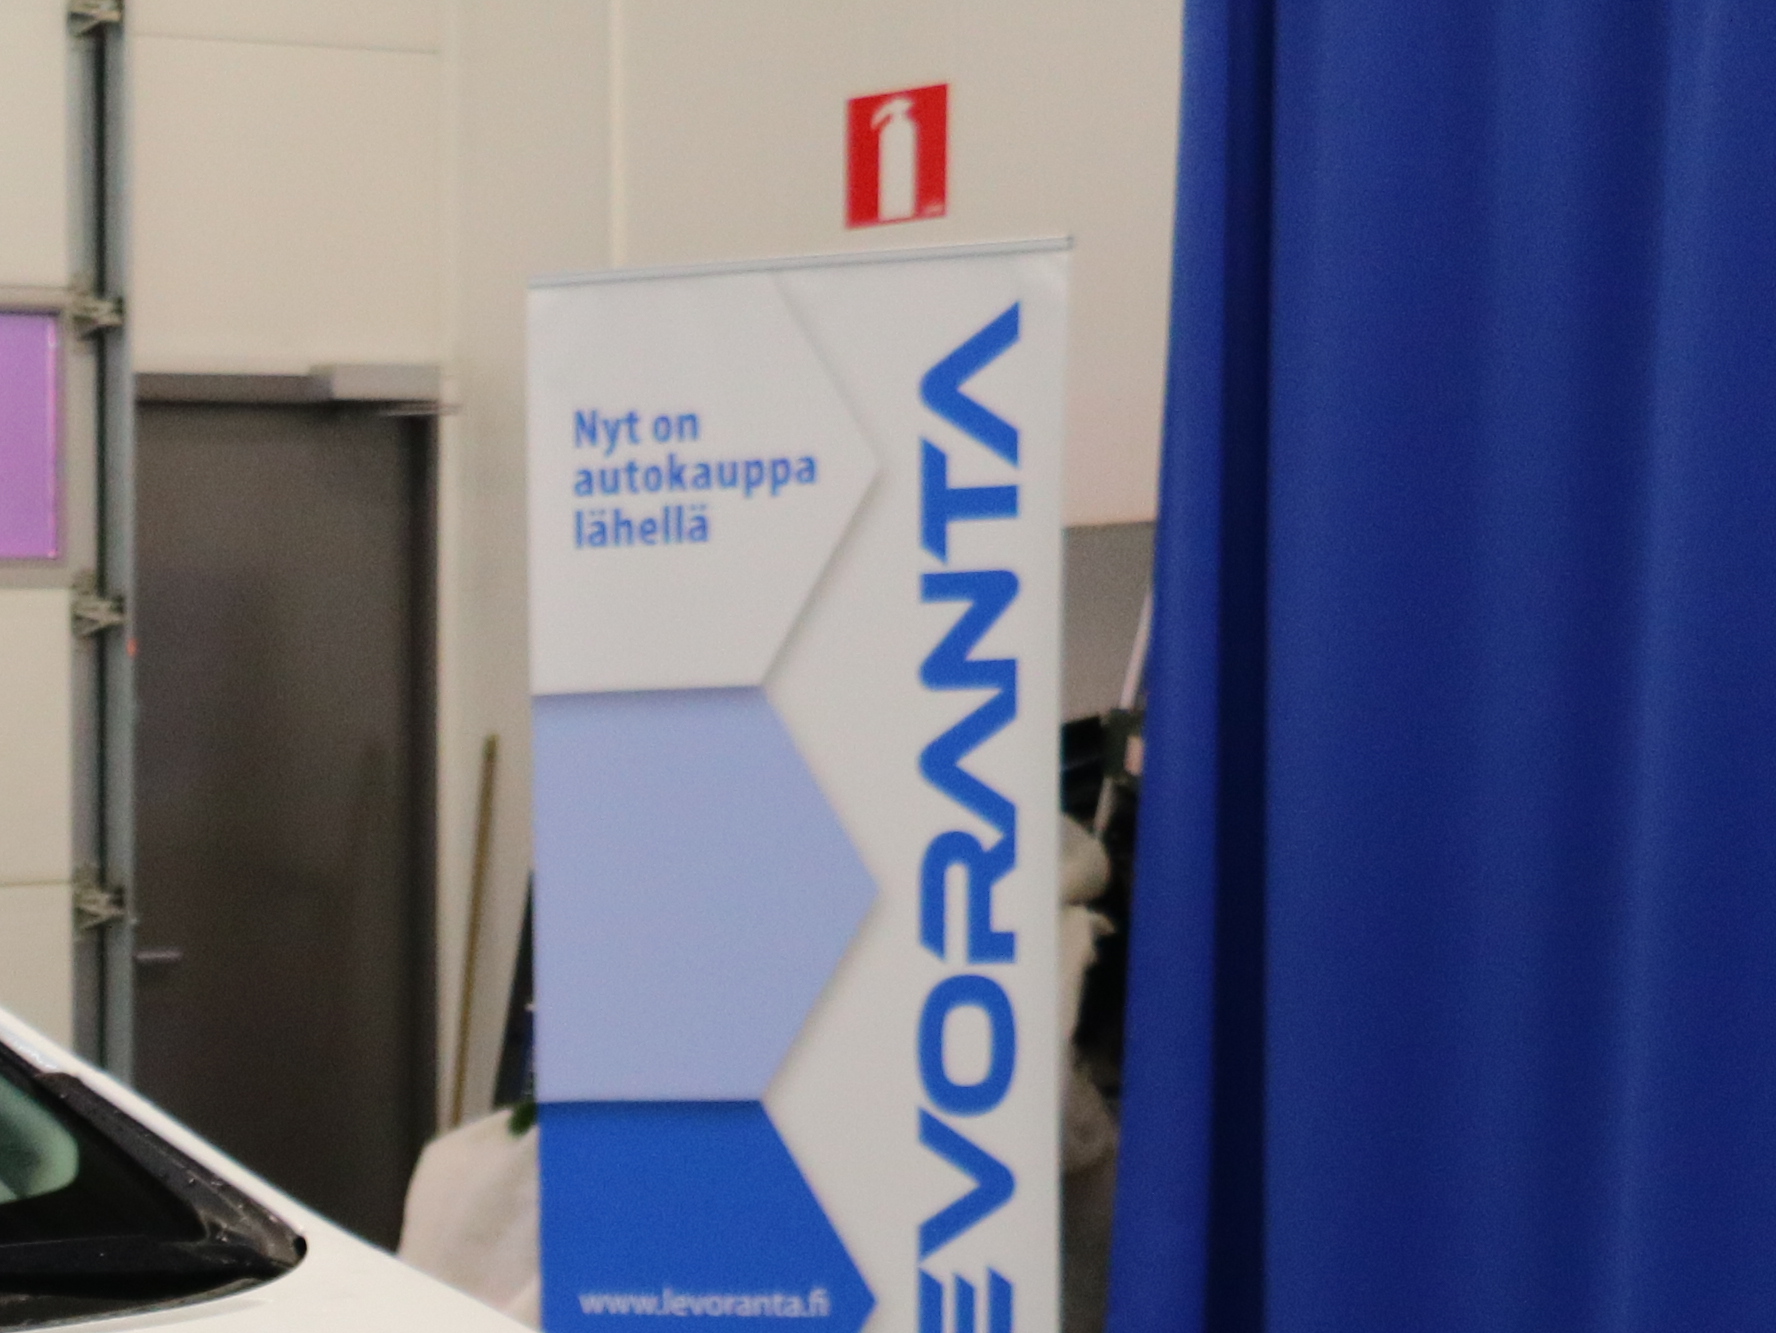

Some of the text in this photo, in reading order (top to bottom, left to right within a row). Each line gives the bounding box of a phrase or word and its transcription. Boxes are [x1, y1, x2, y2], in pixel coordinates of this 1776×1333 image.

[573, 408, 700, 457] Nyt on
[573, 452, 819, 498] autokauppa
[574, 504, 711, 549] lähellä
[578, 1285, 832, 1319] www.levoranta.fi
